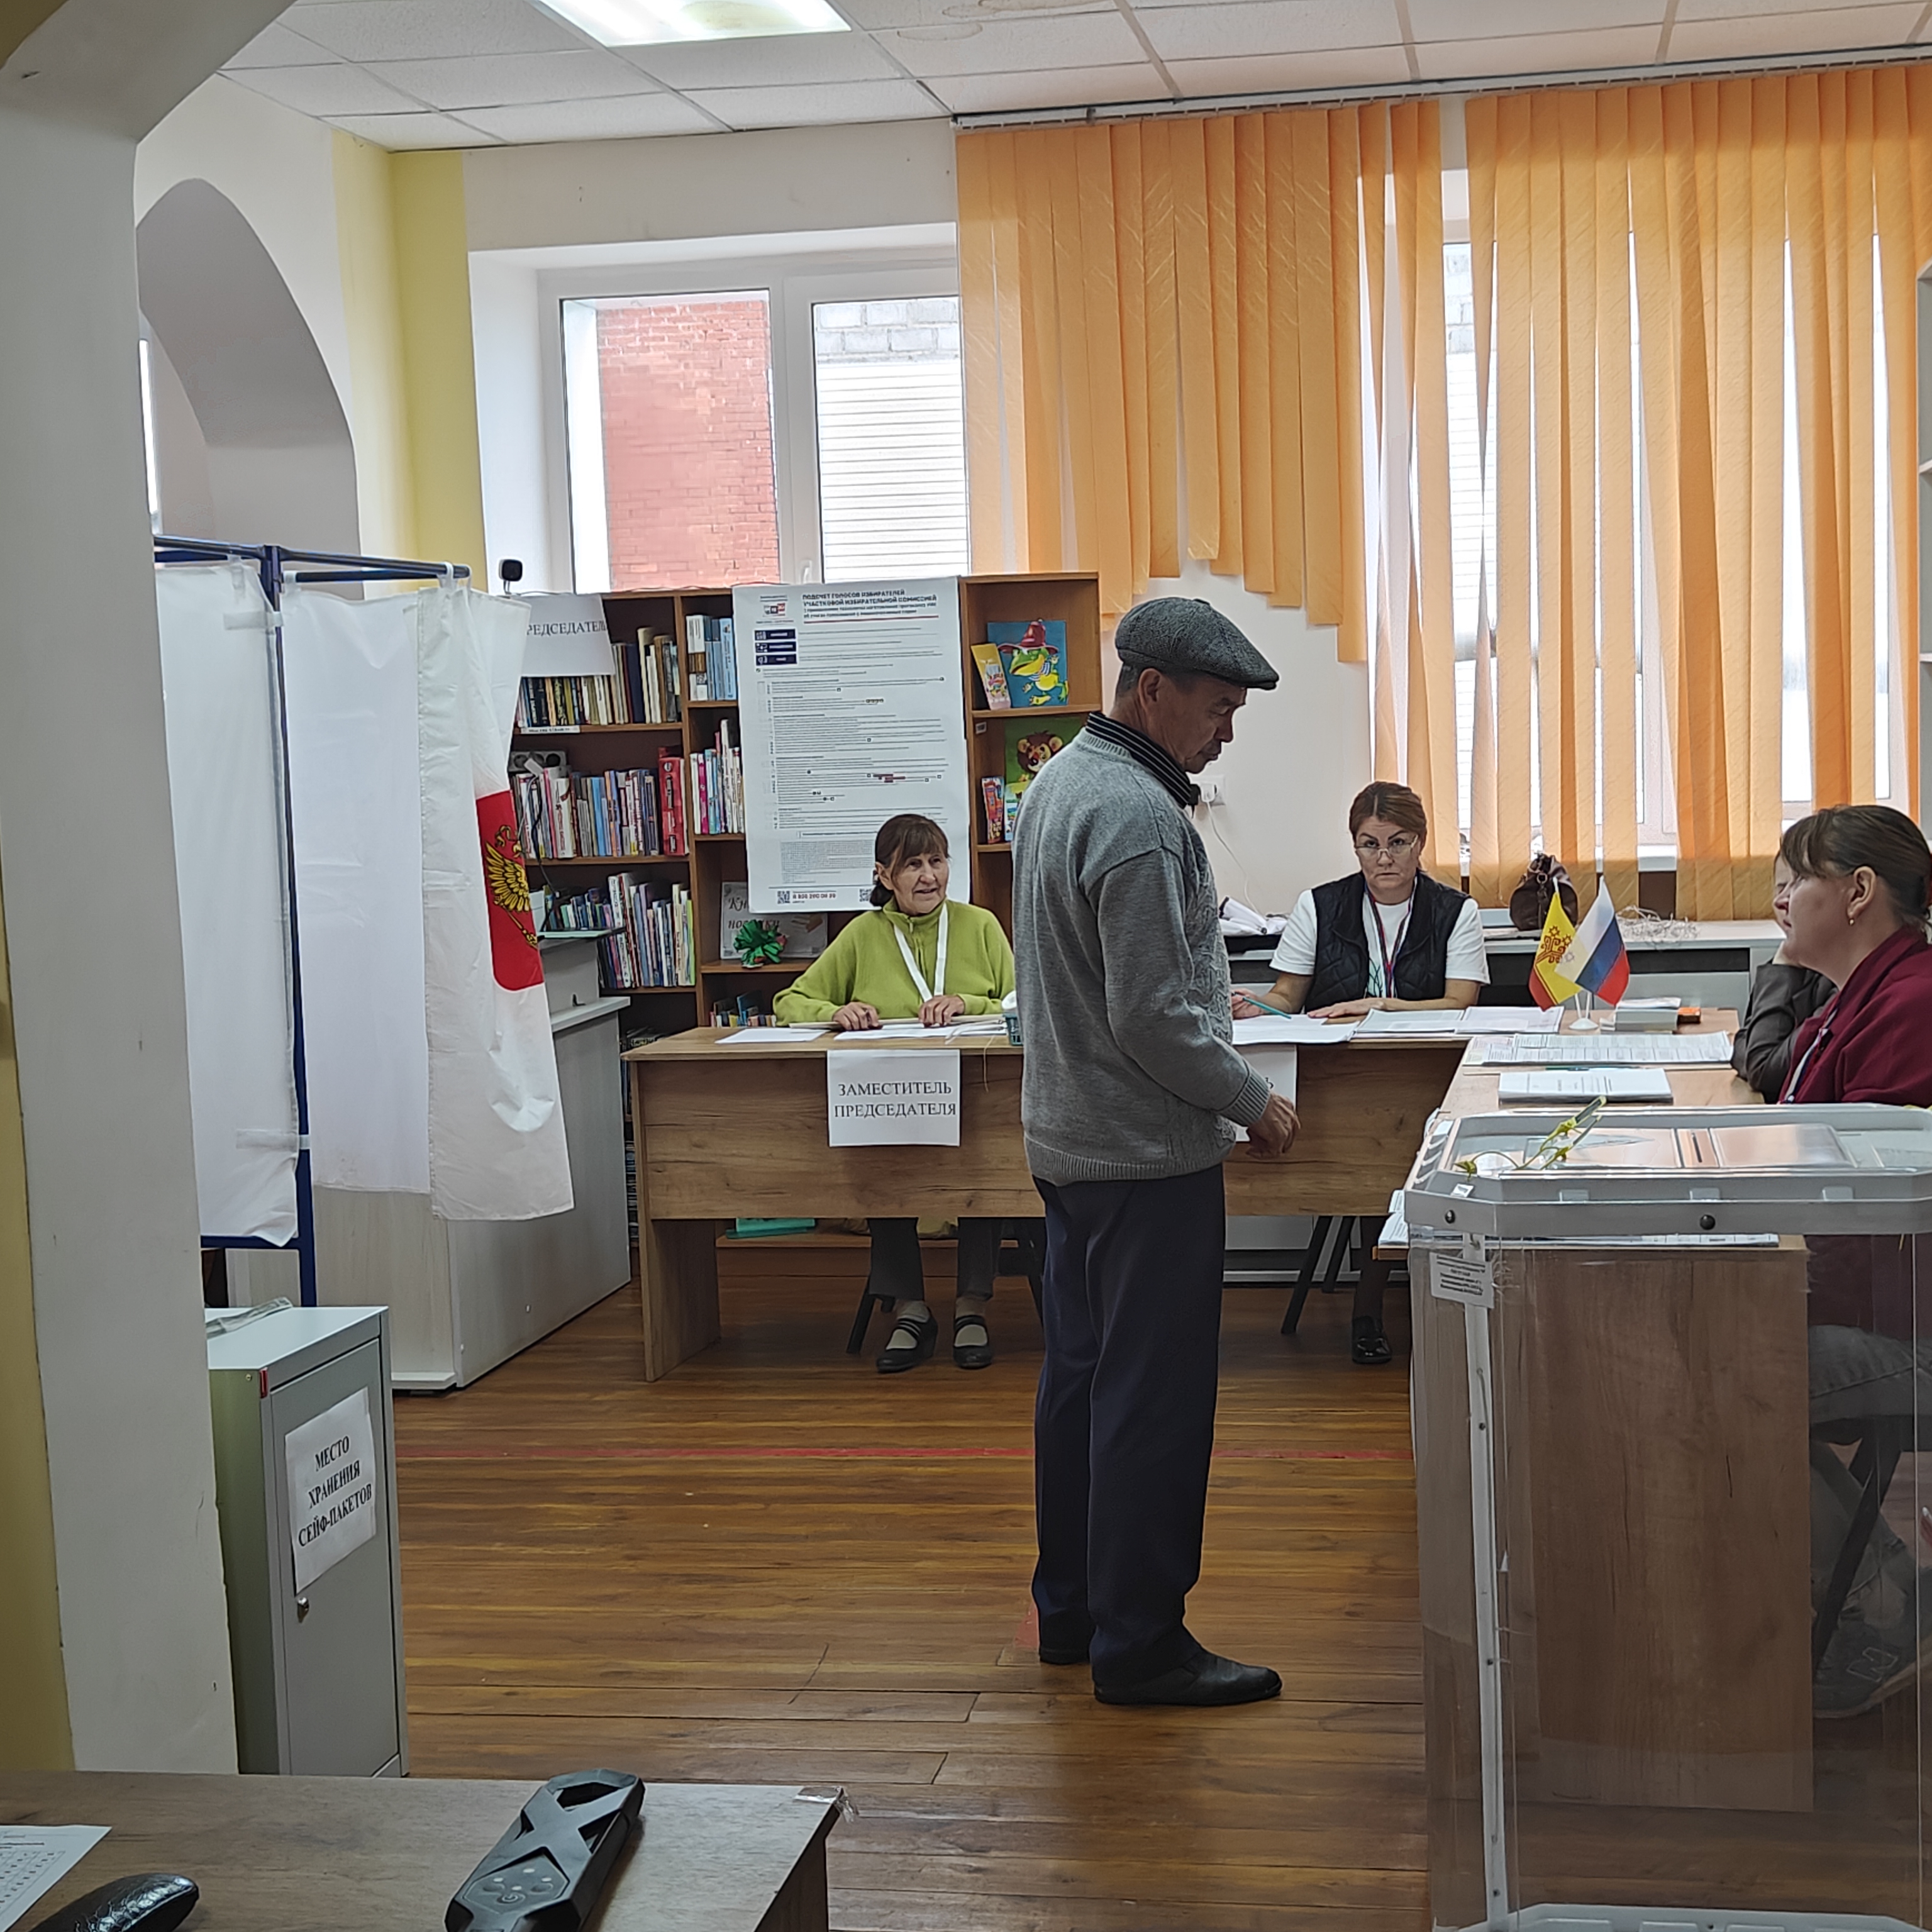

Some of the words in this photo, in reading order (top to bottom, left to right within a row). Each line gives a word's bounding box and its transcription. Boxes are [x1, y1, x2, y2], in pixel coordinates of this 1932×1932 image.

[862, 589, 904, 597] ИЗБИРАТЕЛЕЙ
[838, 1082, 952, 1096] ЗАМЕСТИТЕЛЬ
[835, 1103, 956, 1118] ПРЕДСЕДАТЕЛЯ
[315, 1436, 350, 1472] МЕСТО
[308, 1460, 360, 1509] ХРАНЕНИЯ
[298, 1483, 372, 1547] СЕЙФ-ПАКЕТОВ
